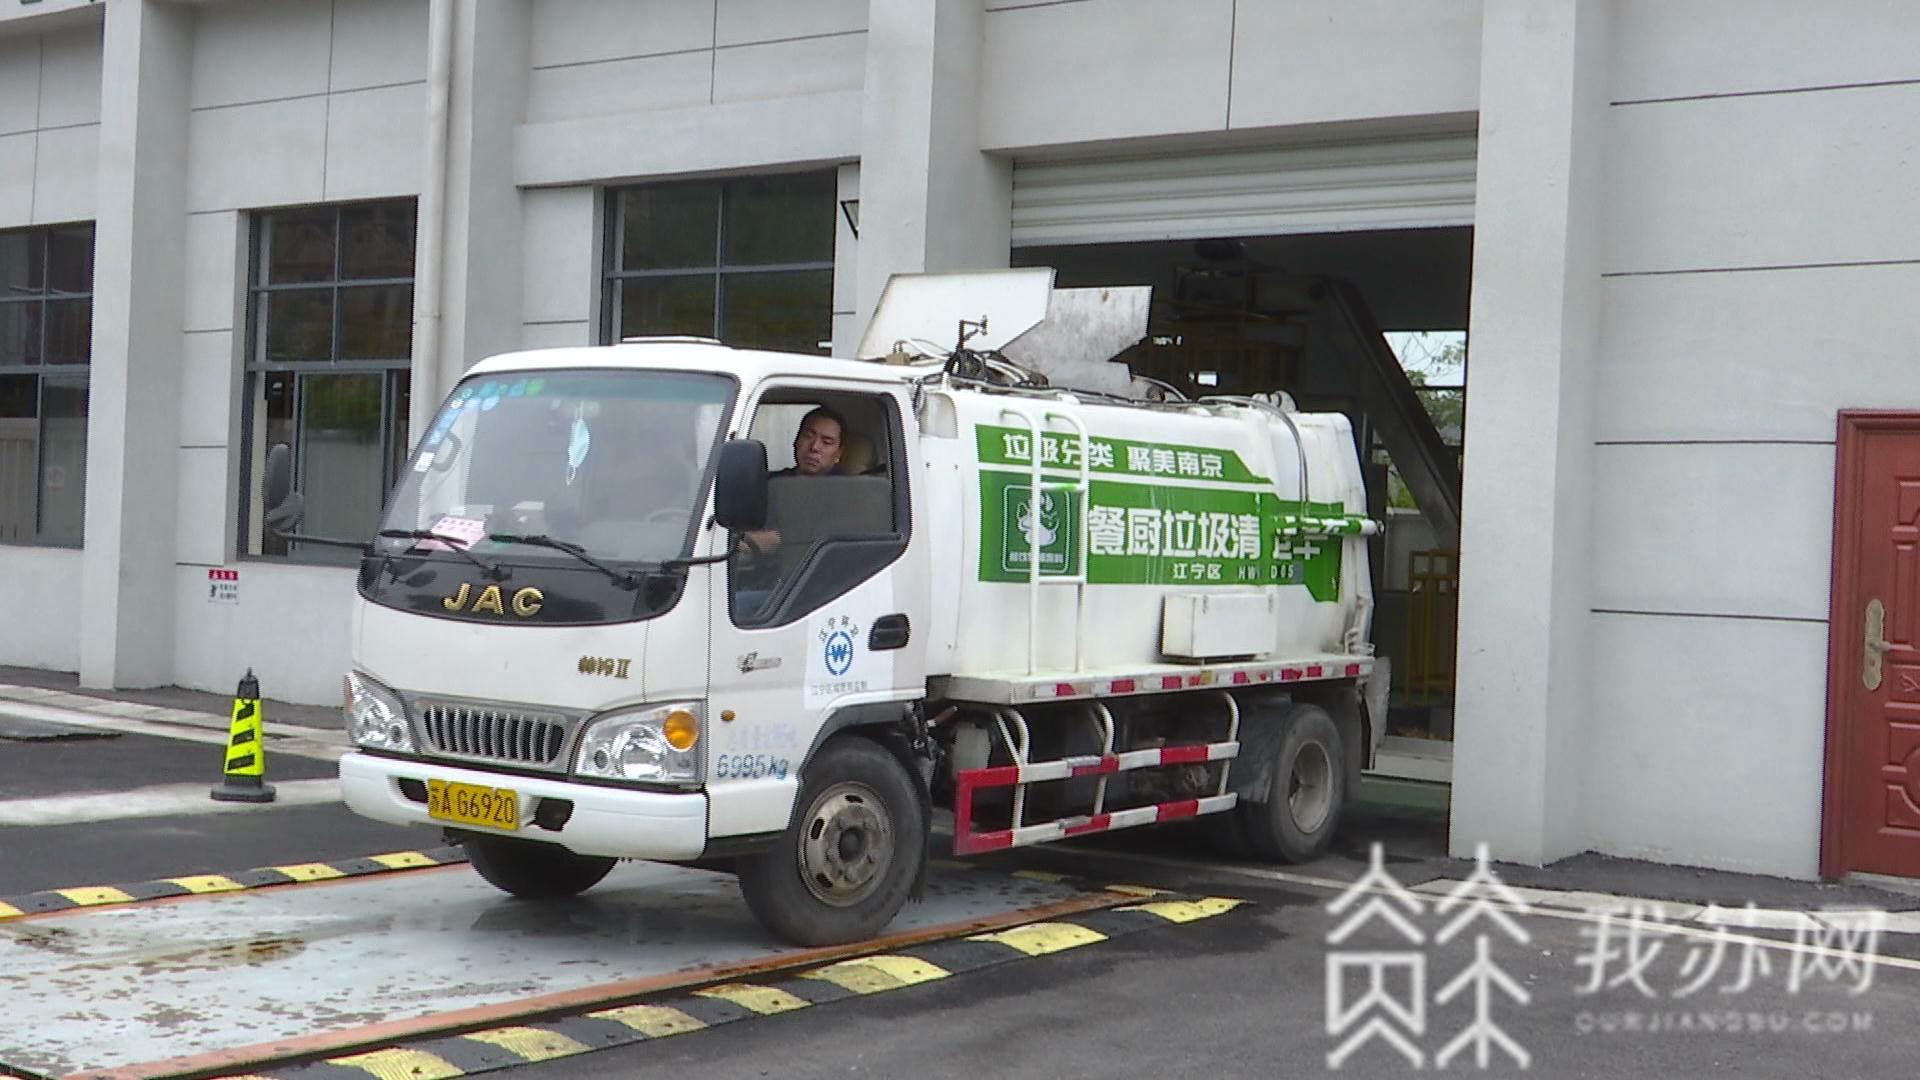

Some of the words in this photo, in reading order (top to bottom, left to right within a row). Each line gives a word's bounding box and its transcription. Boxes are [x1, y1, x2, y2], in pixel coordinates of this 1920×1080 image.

[1127, 445, 1224, 478] 聚美南京
[1173, 563, 1222, 580] 江宁区
[443, 582, 545, 617] JAC
